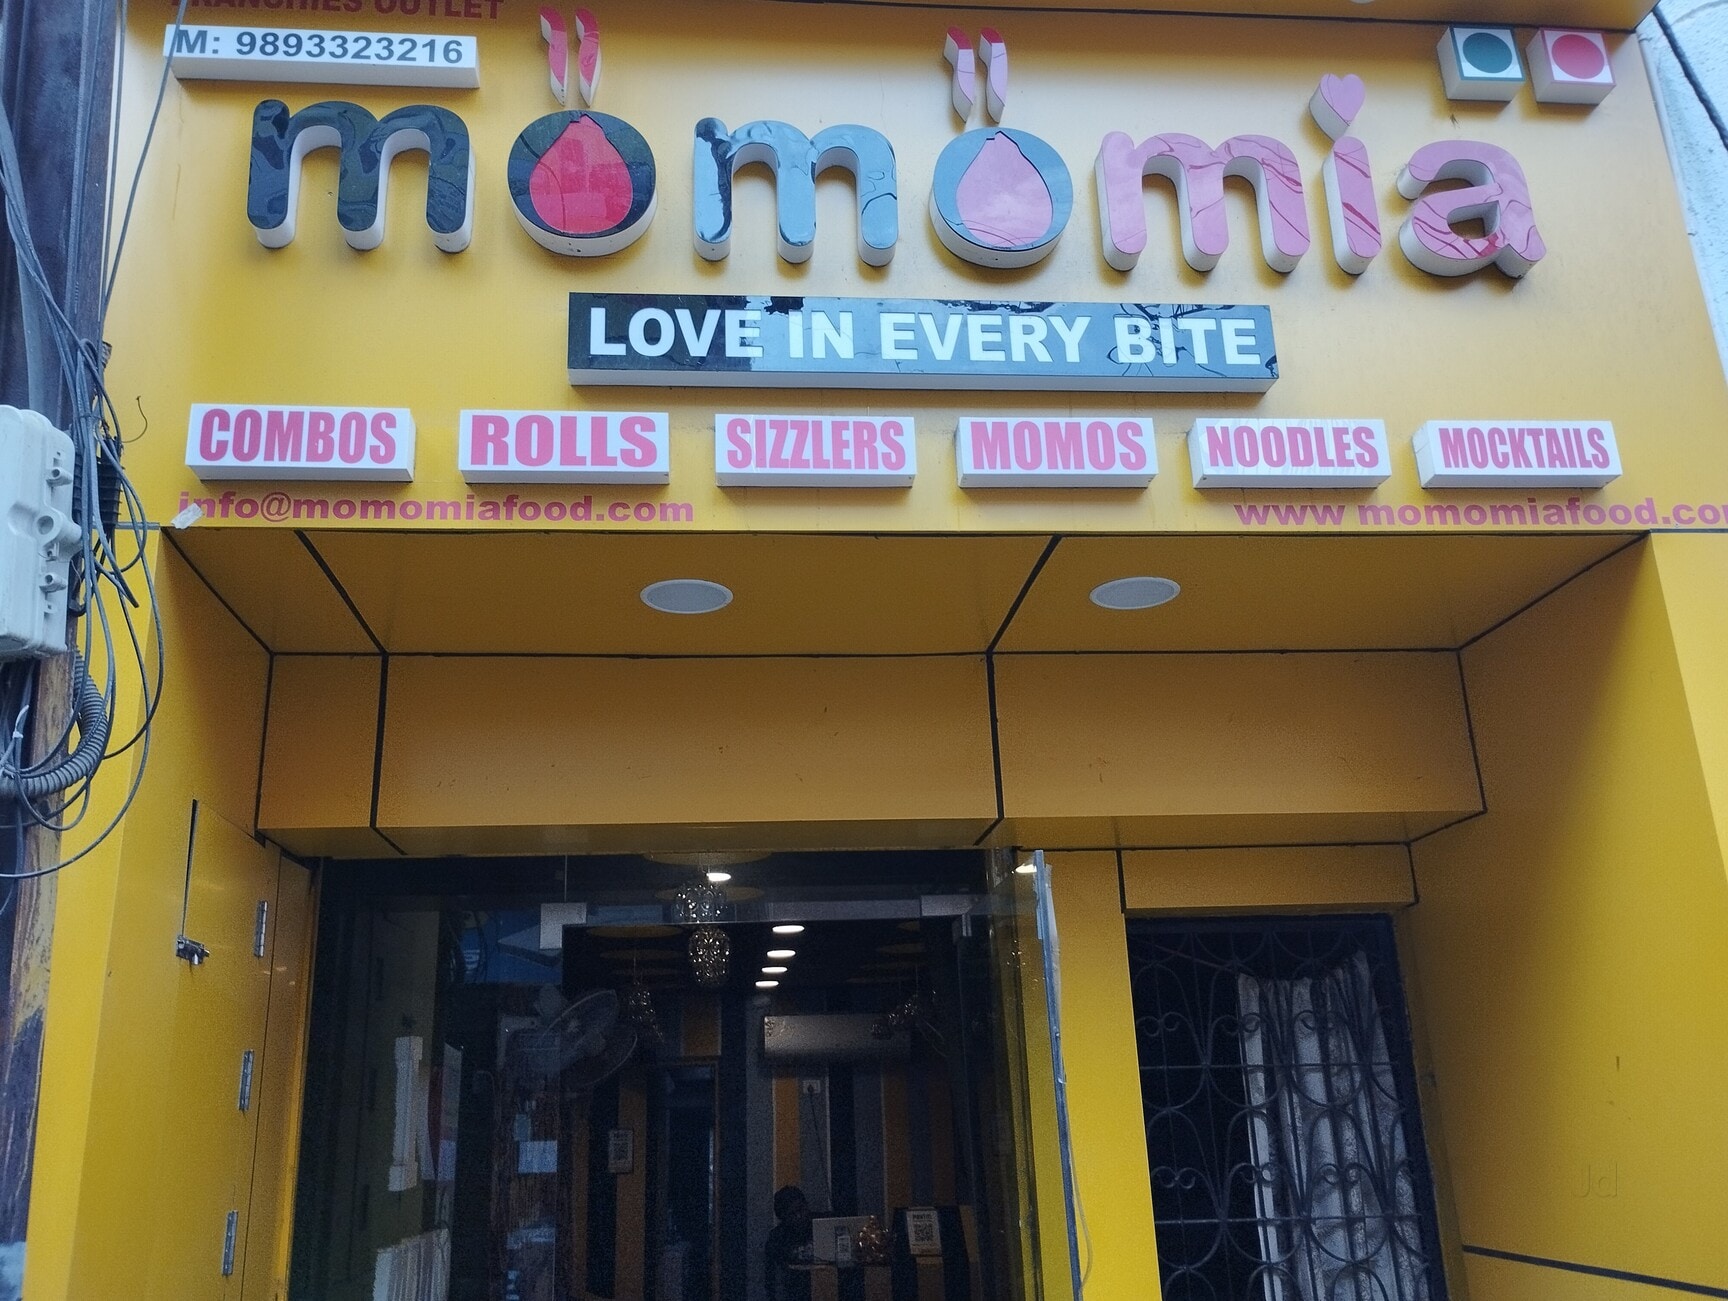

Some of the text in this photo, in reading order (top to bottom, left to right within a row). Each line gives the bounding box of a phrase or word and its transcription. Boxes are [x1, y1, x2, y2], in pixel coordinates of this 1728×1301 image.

[175, 29, 463, 63] M: 9893323216
[247, 74, 1546, 278] momomia
[588, 307, 1261, 366] LOVE IN EVERY BITE
[200, 408, 397, 465] COMBOS
[471, 415, 658, 468] ROLLS
[726, 418, 906, 471] SIZZLERS
[970, 421, 1147, 470] MOMOS
[1205, 426, 1379, 468] NOODLES
[1438, 427, 1610, 470] MOCKTAILS
[179, 491, 694, 523] info@momomiafood.com
[1357, 497, 1728, 526] momomiafood.co
